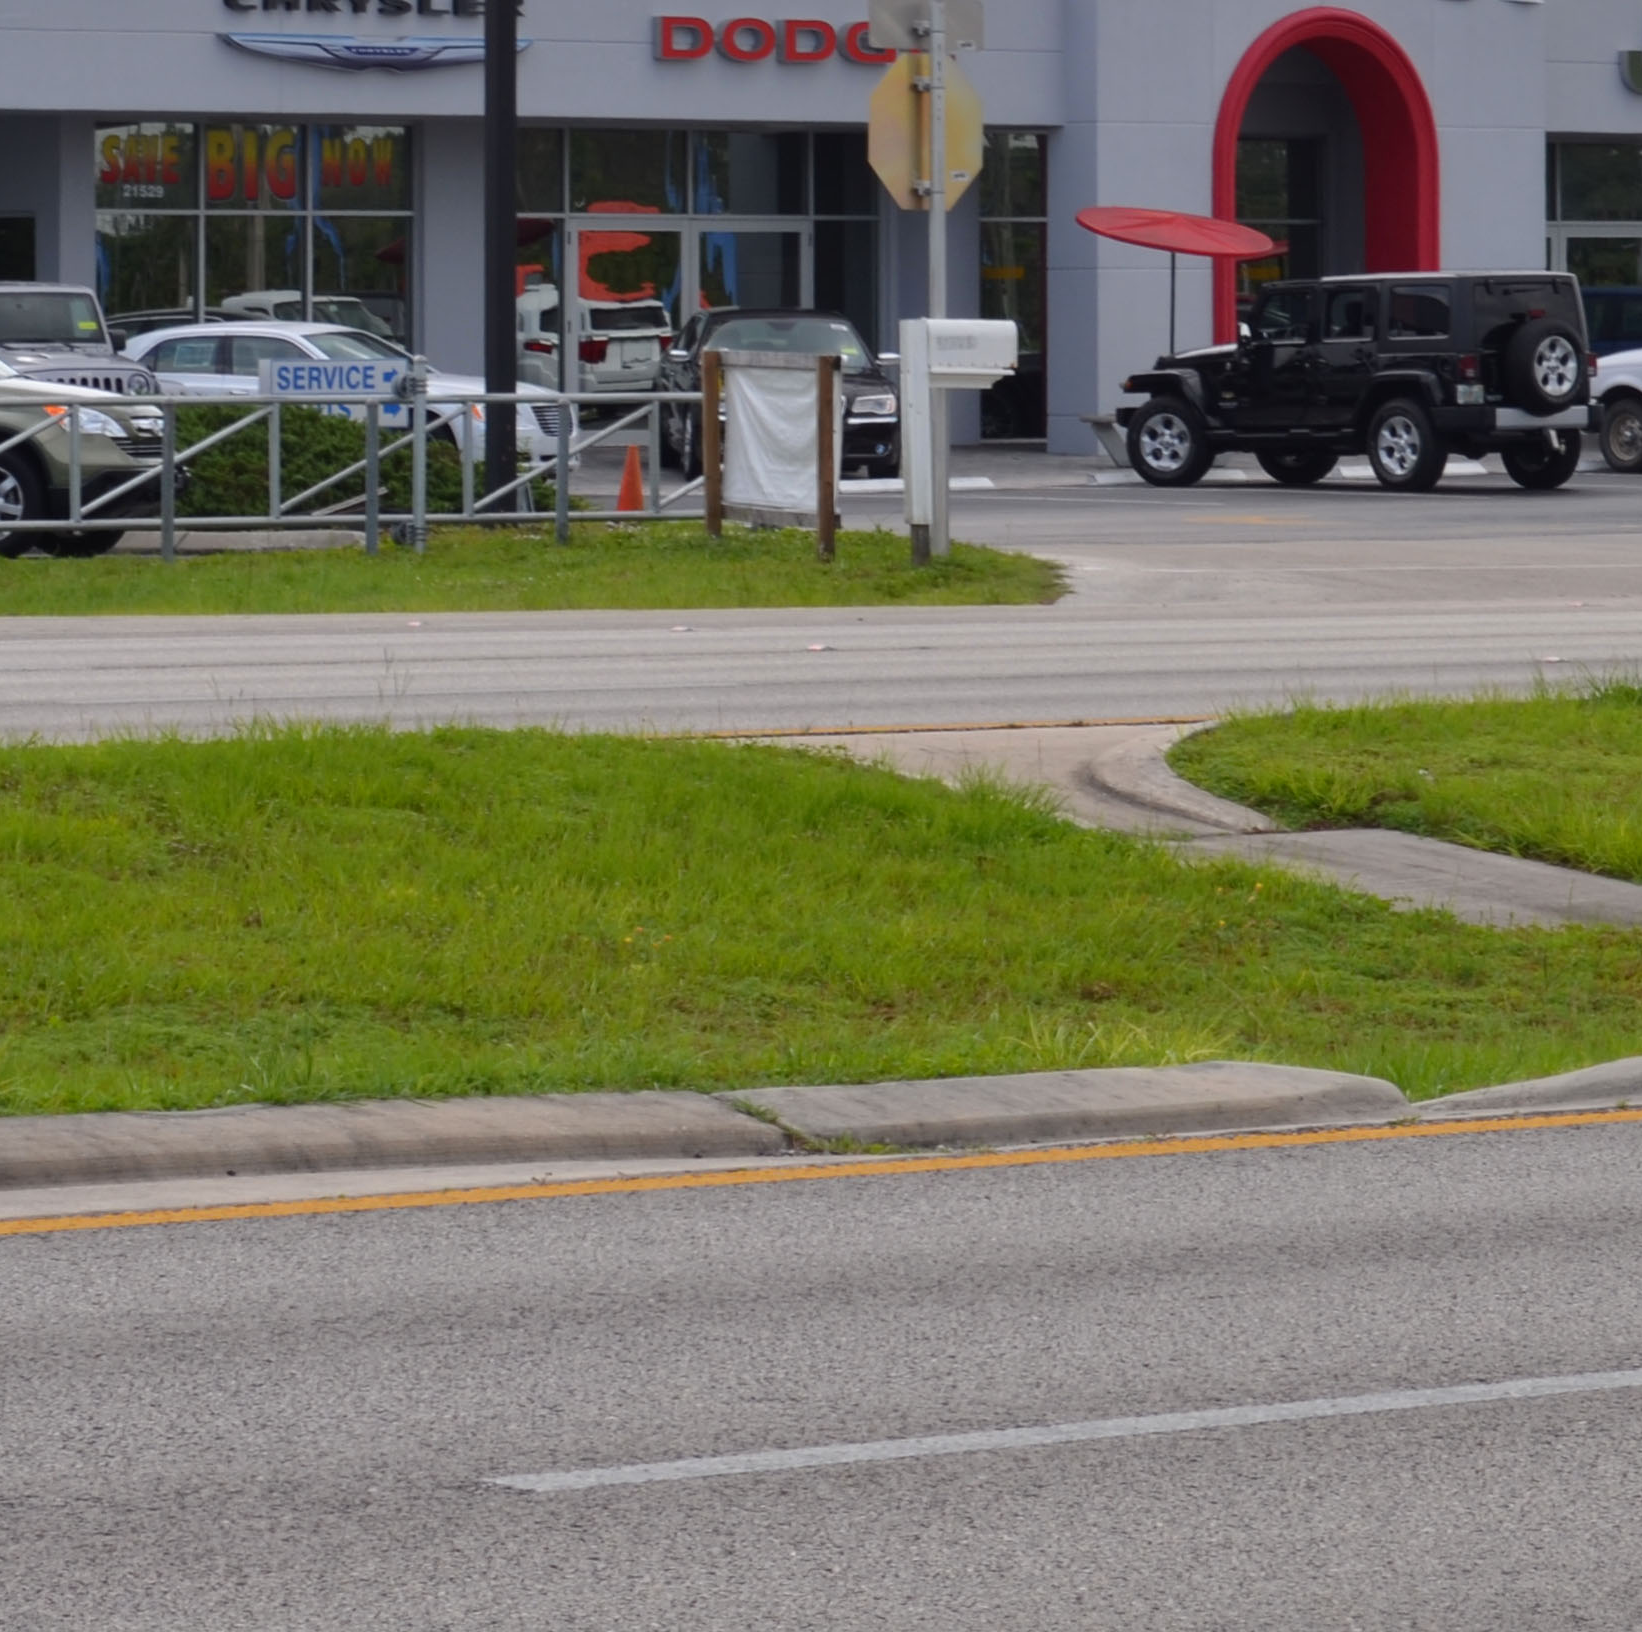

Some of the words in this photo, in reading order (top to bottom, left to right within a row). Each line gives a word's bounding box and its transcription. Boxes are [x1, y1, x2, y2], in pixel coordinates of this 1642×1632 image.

[652, 16, 957, 65] DODG
[101, 134, 180, 184] SAVE
[207, 129, 297, 202] BIG
[321, 137, 393, 187] NOW
[276, 366, 376, 390] SERVICE
